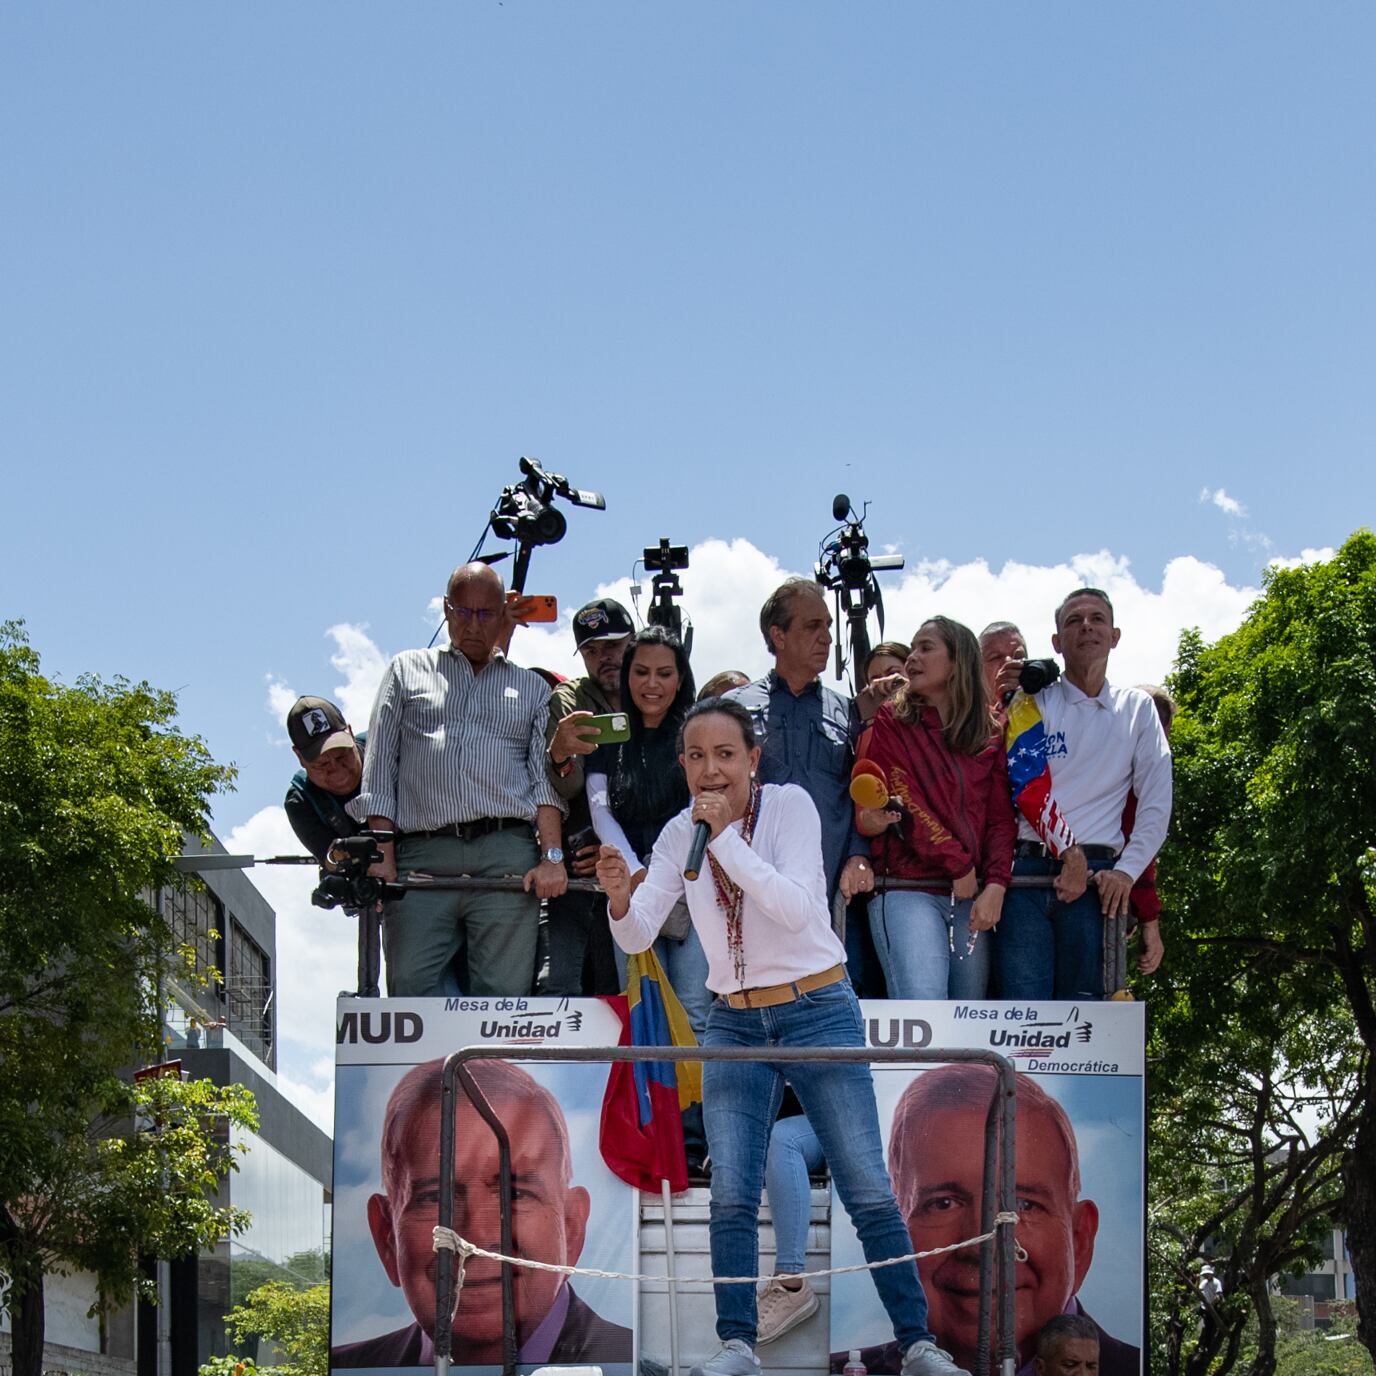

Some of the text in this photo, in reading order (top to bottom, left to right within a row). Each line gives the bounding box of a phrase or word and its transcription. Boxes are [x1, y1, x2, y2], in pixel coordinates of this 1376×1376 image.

[444, 997, 528, 1012] Mesa de la
[953, 1005, 1038, 1021] Mesa de la
[479, 1020, 562, 1039] Unidad
[862, 1018, 933, 1048] UD
[989, 1030, 1071, 1049] Unidad
[1027, 1058, 1120, 1073] Democrática
